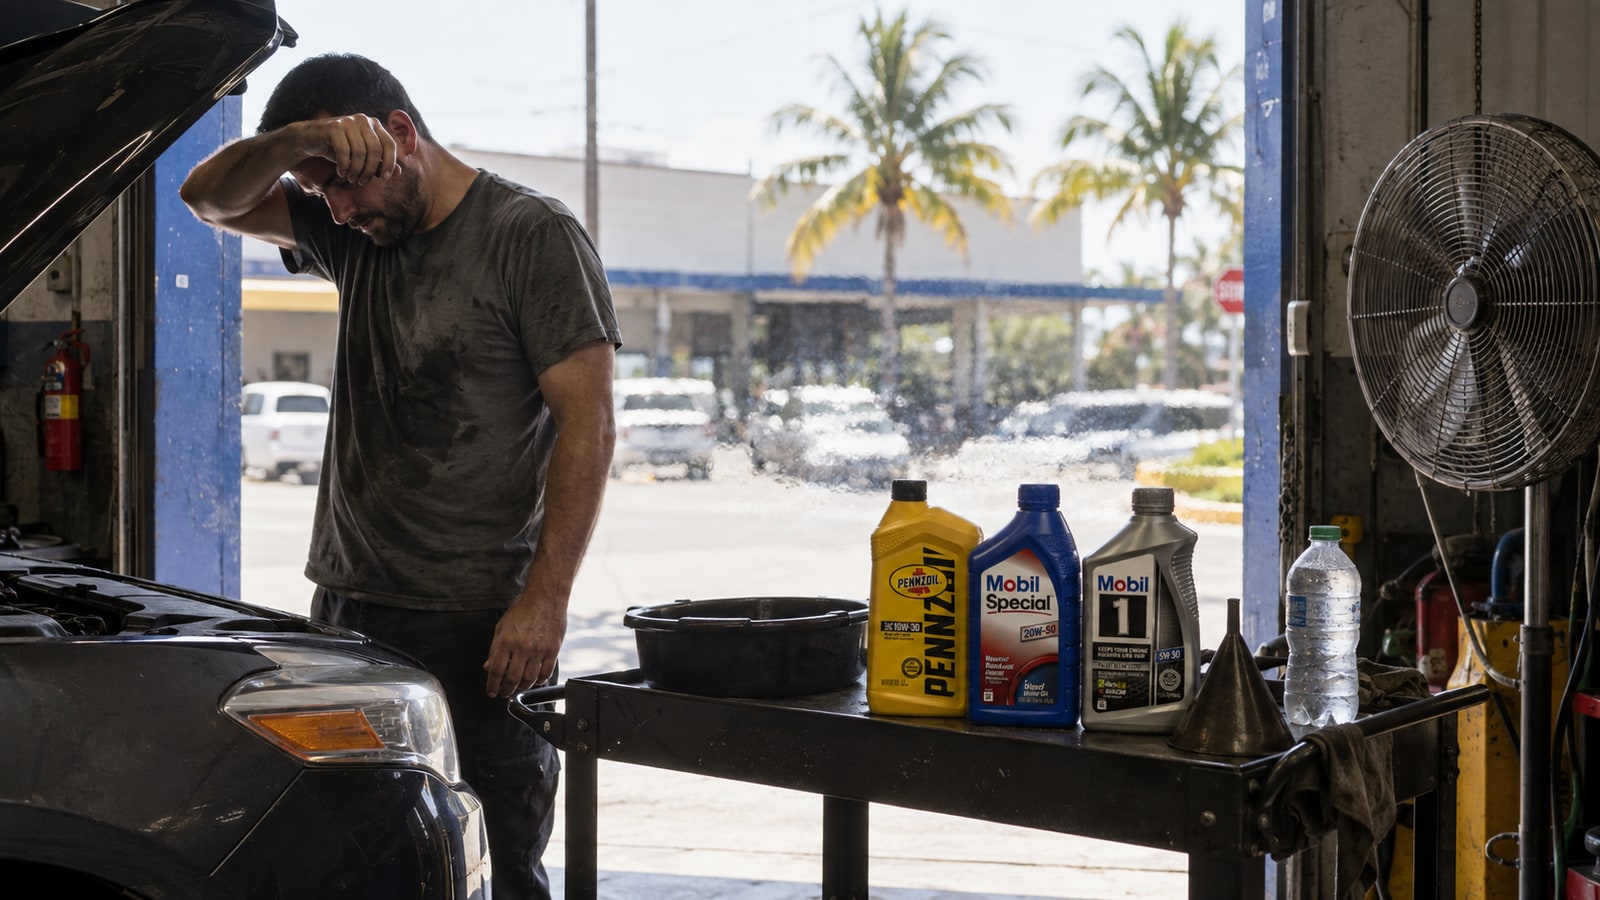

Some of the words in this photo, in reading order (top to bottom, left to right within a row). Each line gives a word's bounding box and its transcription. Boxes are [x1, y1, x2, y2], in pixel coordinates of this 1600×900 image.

[897, 574, 939, 589] PENNZOIL
[986, 575, 1040, 592] Mobil
[1098, 575, 1149, 592] Mobil
[986, 593, 1051, 613] Special
[1113, 597, 1129, 636] 1
[893, 622, 920, 632] 10W-30
[1023, 624, 1056, 639] 20W-50
